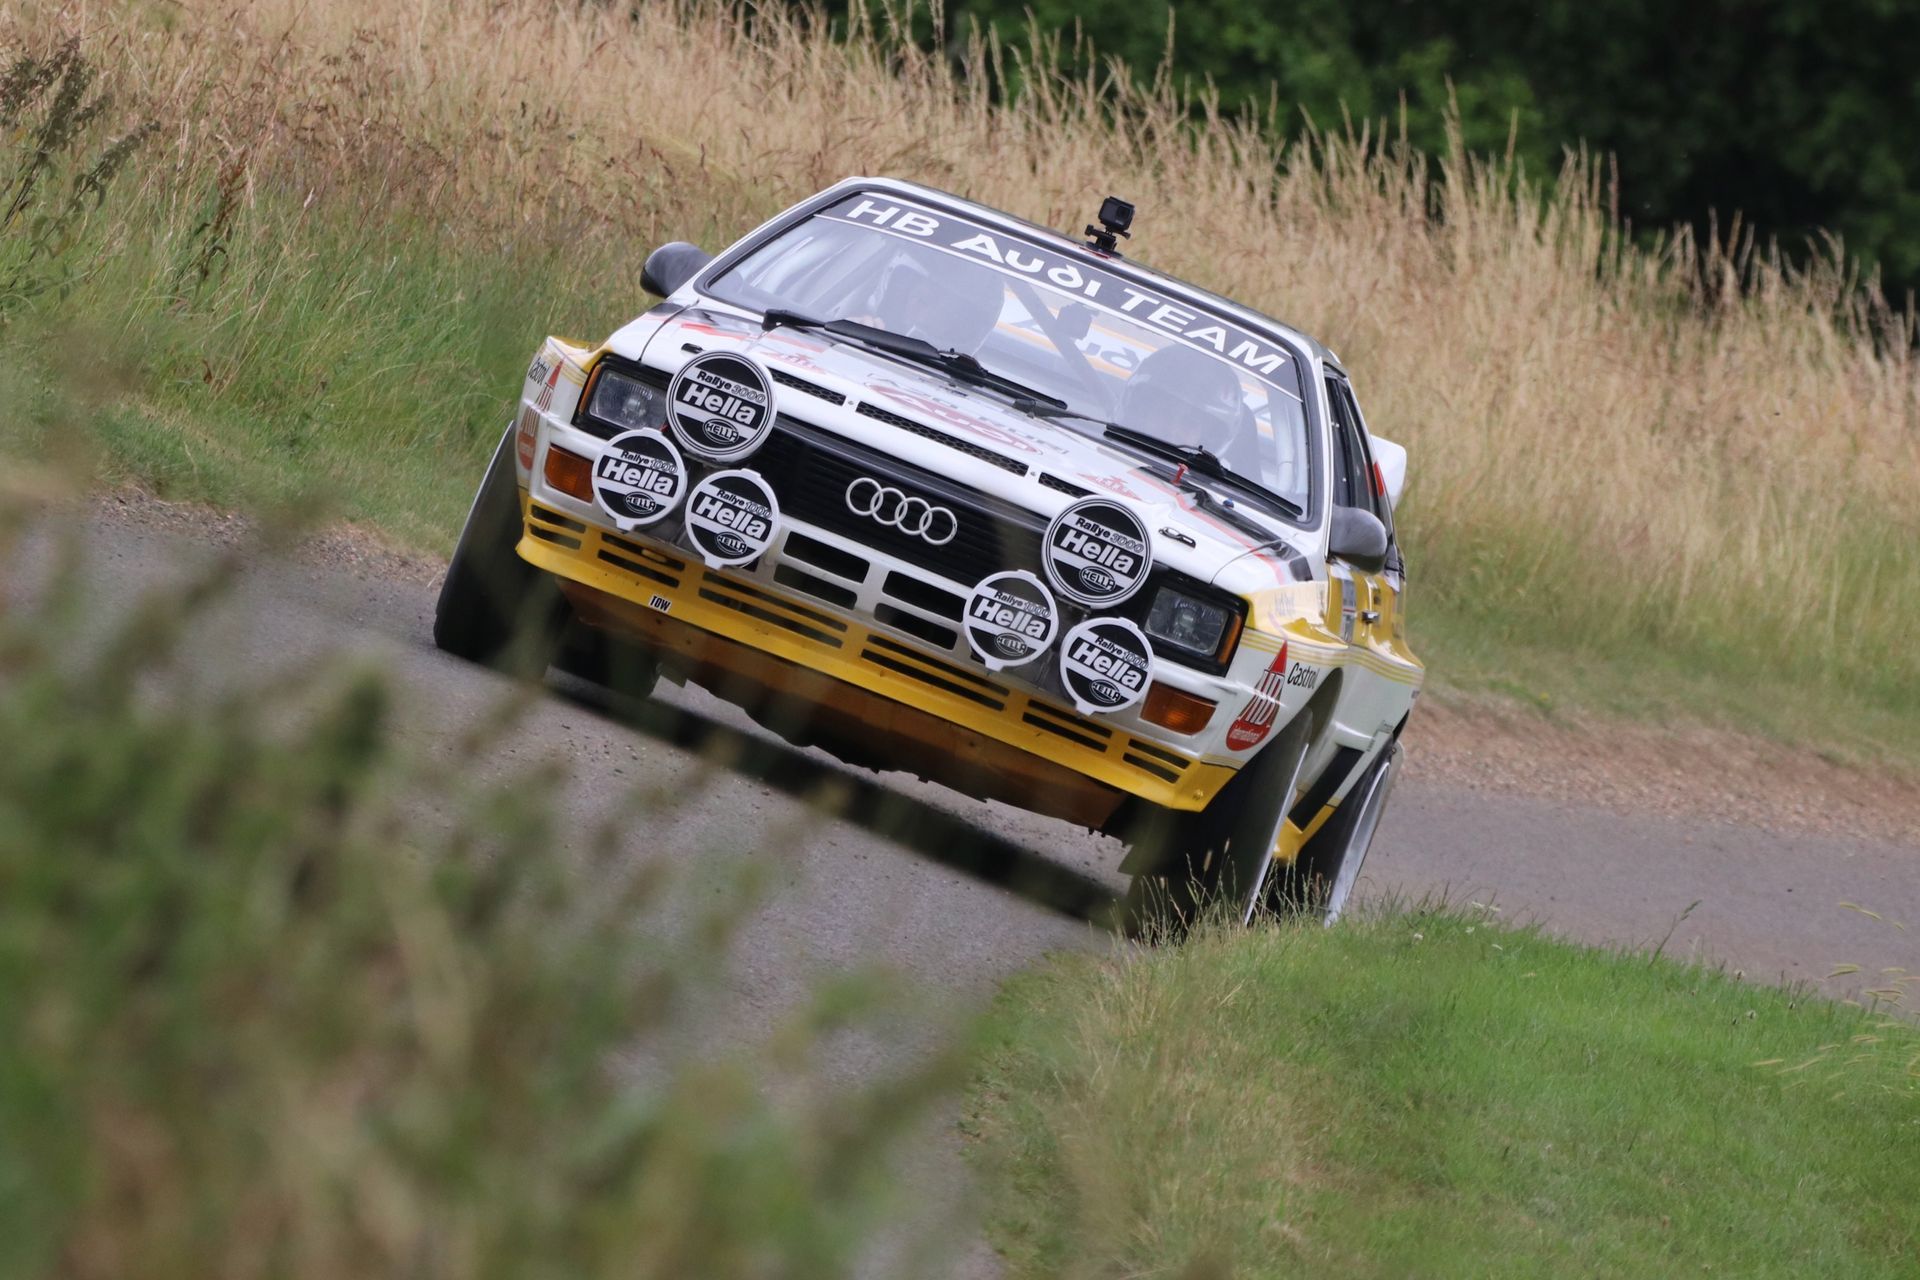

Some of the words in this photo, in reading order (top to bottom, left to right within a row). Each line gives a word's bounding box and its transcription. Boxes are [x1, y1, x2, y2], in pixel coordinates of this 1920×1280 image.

[846, 200, 940, 237] HB
[1119, 288, 1287, 375] TEAM
[696, 370, 732, 391] Rallye
[730, 384, 766, 404] 3000
[683, 382, 756, 425] Hella
[705, 423, 740, 445] HELLA
[620, 450, 650, 466] Rallye
[602, 459, 674, 497] Hella
[626, 495, 656, 513] HELLA
[696, 495, 767, 539] Hella
[716, 489, 745, 508] Rallye
[744, 501, 772, 519] 1000
[717, 534, 747, 553] HELLA
[1075, 517, 1110, 538] Rallye
[1110, 532, 1144, 553] 3000
[1060, 528, 1135, 574] Hella
[1082, 570, 1116, 591] HELLA
[650, 595, 671, 611] TOW
[994, 591, 1024, 608] Rallye
[974, 597, 1047, 639] Hella
[1094, 635, 1123, 655] Rallye
[1072, 642, 1142, 689] Hella
[1287, 662, 1320, 689] Castrol
[1092, 682, 1121, 702] HELLA
